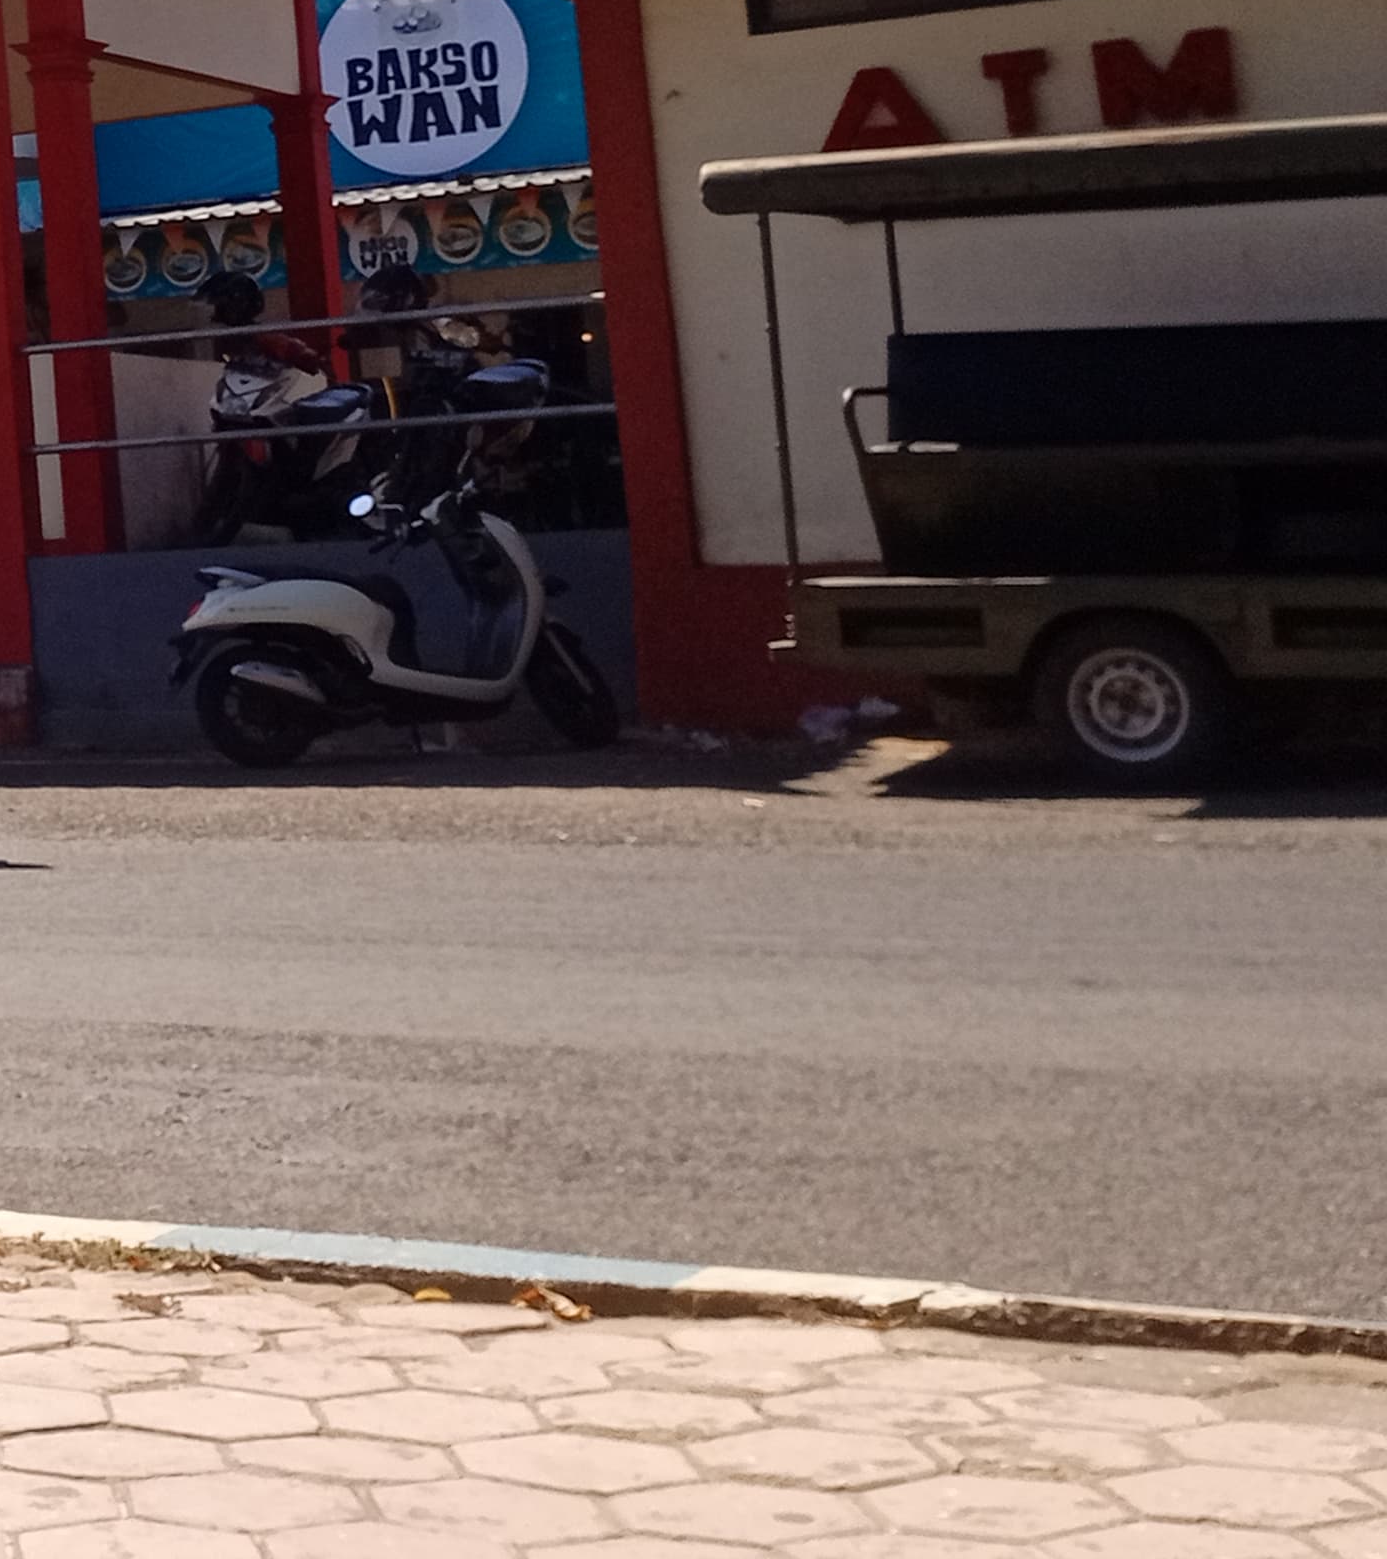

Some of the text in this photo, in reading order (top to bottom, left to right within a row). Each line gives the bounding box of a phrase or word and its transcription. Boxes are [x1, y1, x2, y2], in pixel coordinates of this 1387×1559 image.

[346, 41, 499, 98] BAKSO
[821, 26, 1240, 153] ATM
[347, 84, 502, 147] WAN
